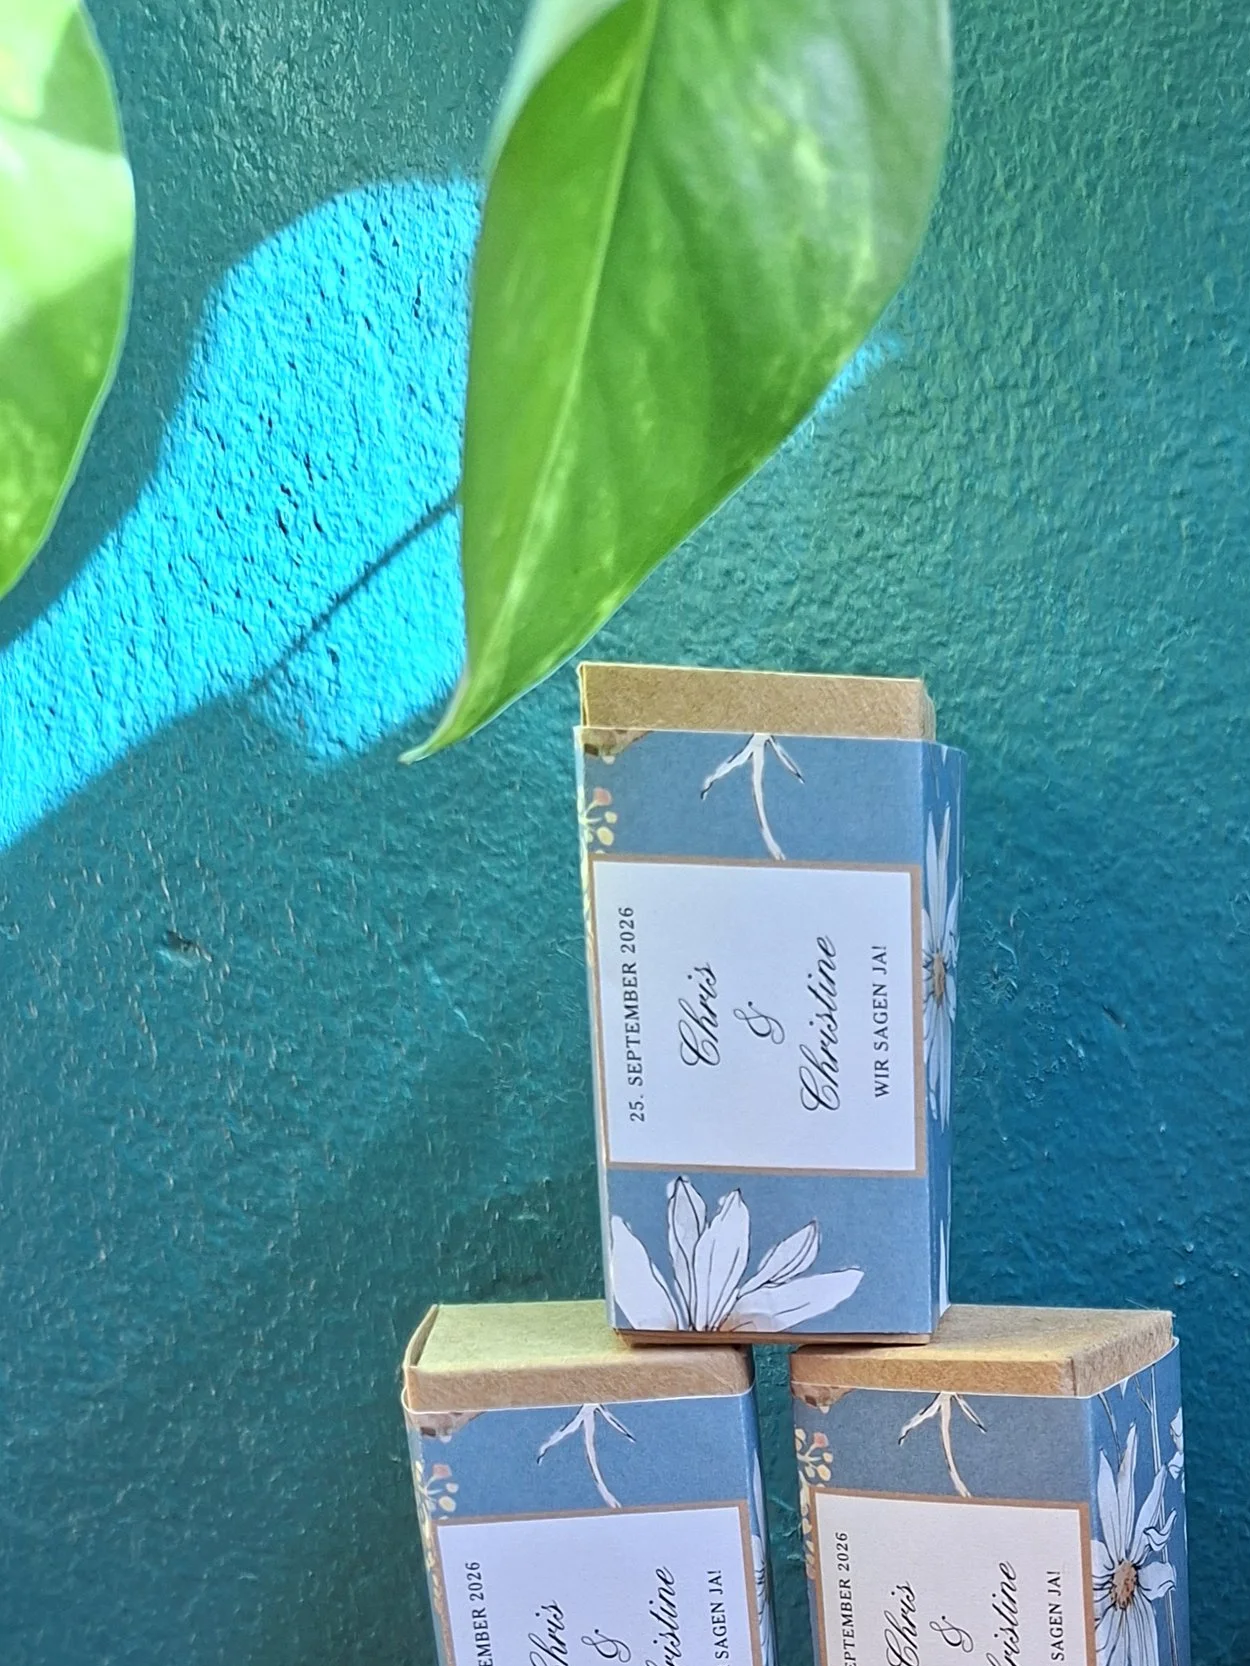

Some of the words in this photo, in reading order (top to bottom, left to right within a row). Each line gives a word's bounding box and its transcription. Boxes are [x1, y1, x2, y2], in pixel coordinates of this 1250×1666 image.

[617, 906, 636, 954] 2026
[870, 945, 888, 976] JA!
[621, 961, 644, 1087] SEPTEMBER
[677, 961, 721, 1067] Chris
[732, 1000, 786, 1045] &
[798, 935, 841, 1112] Christine
[871, 982, 890, 1052] SAGEN
[873, 1058, 890, 1099] WIR
[628, 1094, 646, 1123] 25.
[834, 1531, 851, 1572] 2026
[464, 1561, 485, 1602] 2026
[706, 1569, 724, 1596] JA!
[1045, 1570, 1062, 1597] JA!
[580, 1628, 632, 1664] &
[709, 1601, 730, 1660] SAGEN
[928, 1615, 974, 1654] &
[1047, 1602, 1065, 1662] SAGEN
